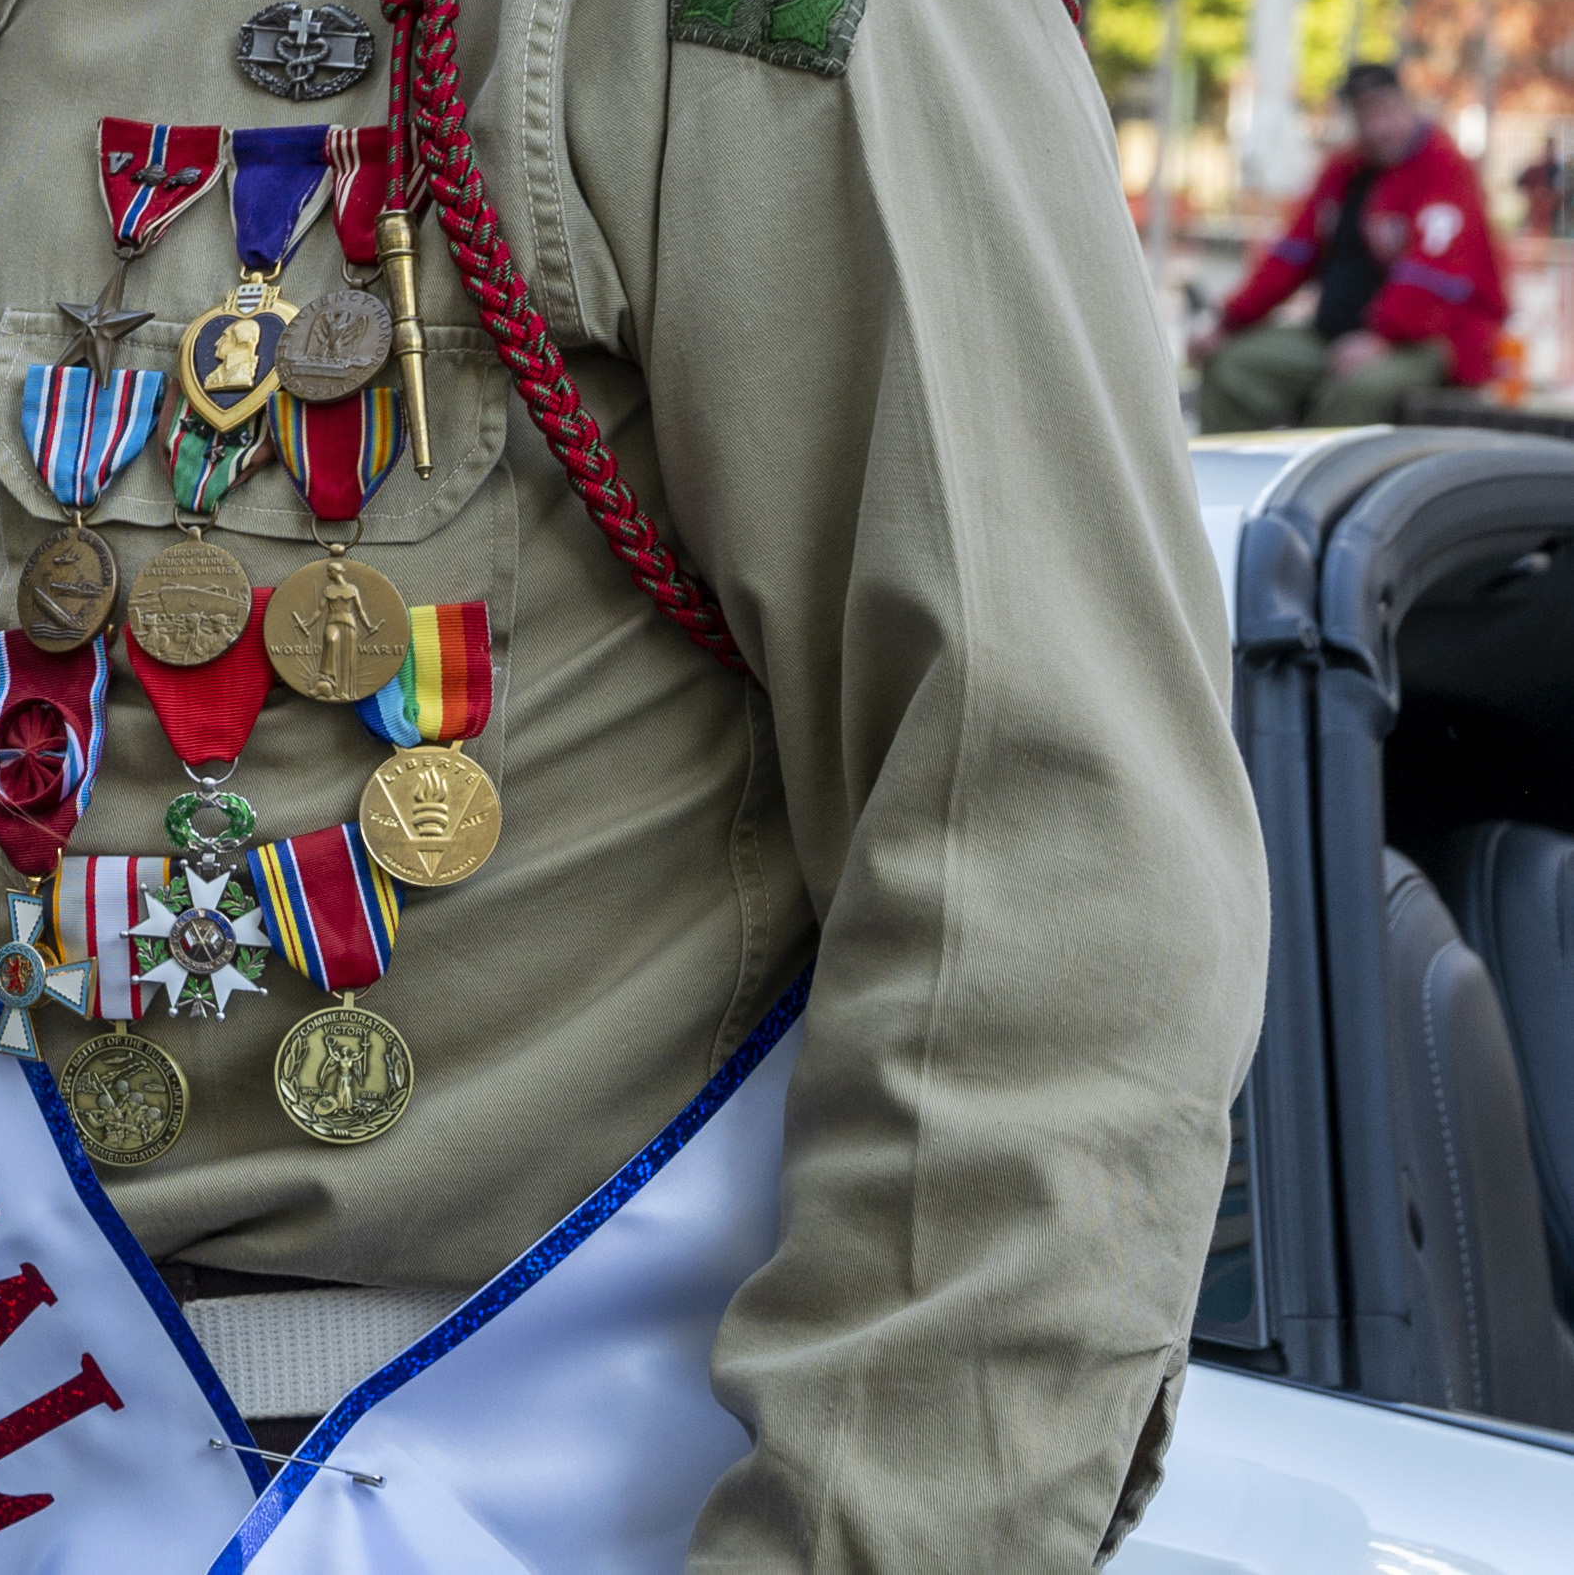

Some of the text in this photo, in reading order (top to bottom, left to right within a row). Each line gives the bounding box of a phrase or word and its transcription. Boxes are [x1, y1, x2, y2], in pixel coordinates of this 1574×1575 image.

[372, 308, 391, 366] HONOR
[270, 644, 322, 657] WORLD
[357, 645, 390, 657] WAR
[299, 1012, 395, 1043] COMMEMORATING
[323, 1025, 371, 1037] VICTORY
[71, 1040, 107, 1068] BATTLE
[106, 1036, 123, 1046] OF
[123, 1037, 144, 1050] THE
[144, 1045, 175, 1077] BULGE
[79, 1135, 167, 1164] COMMEMORATIVE
